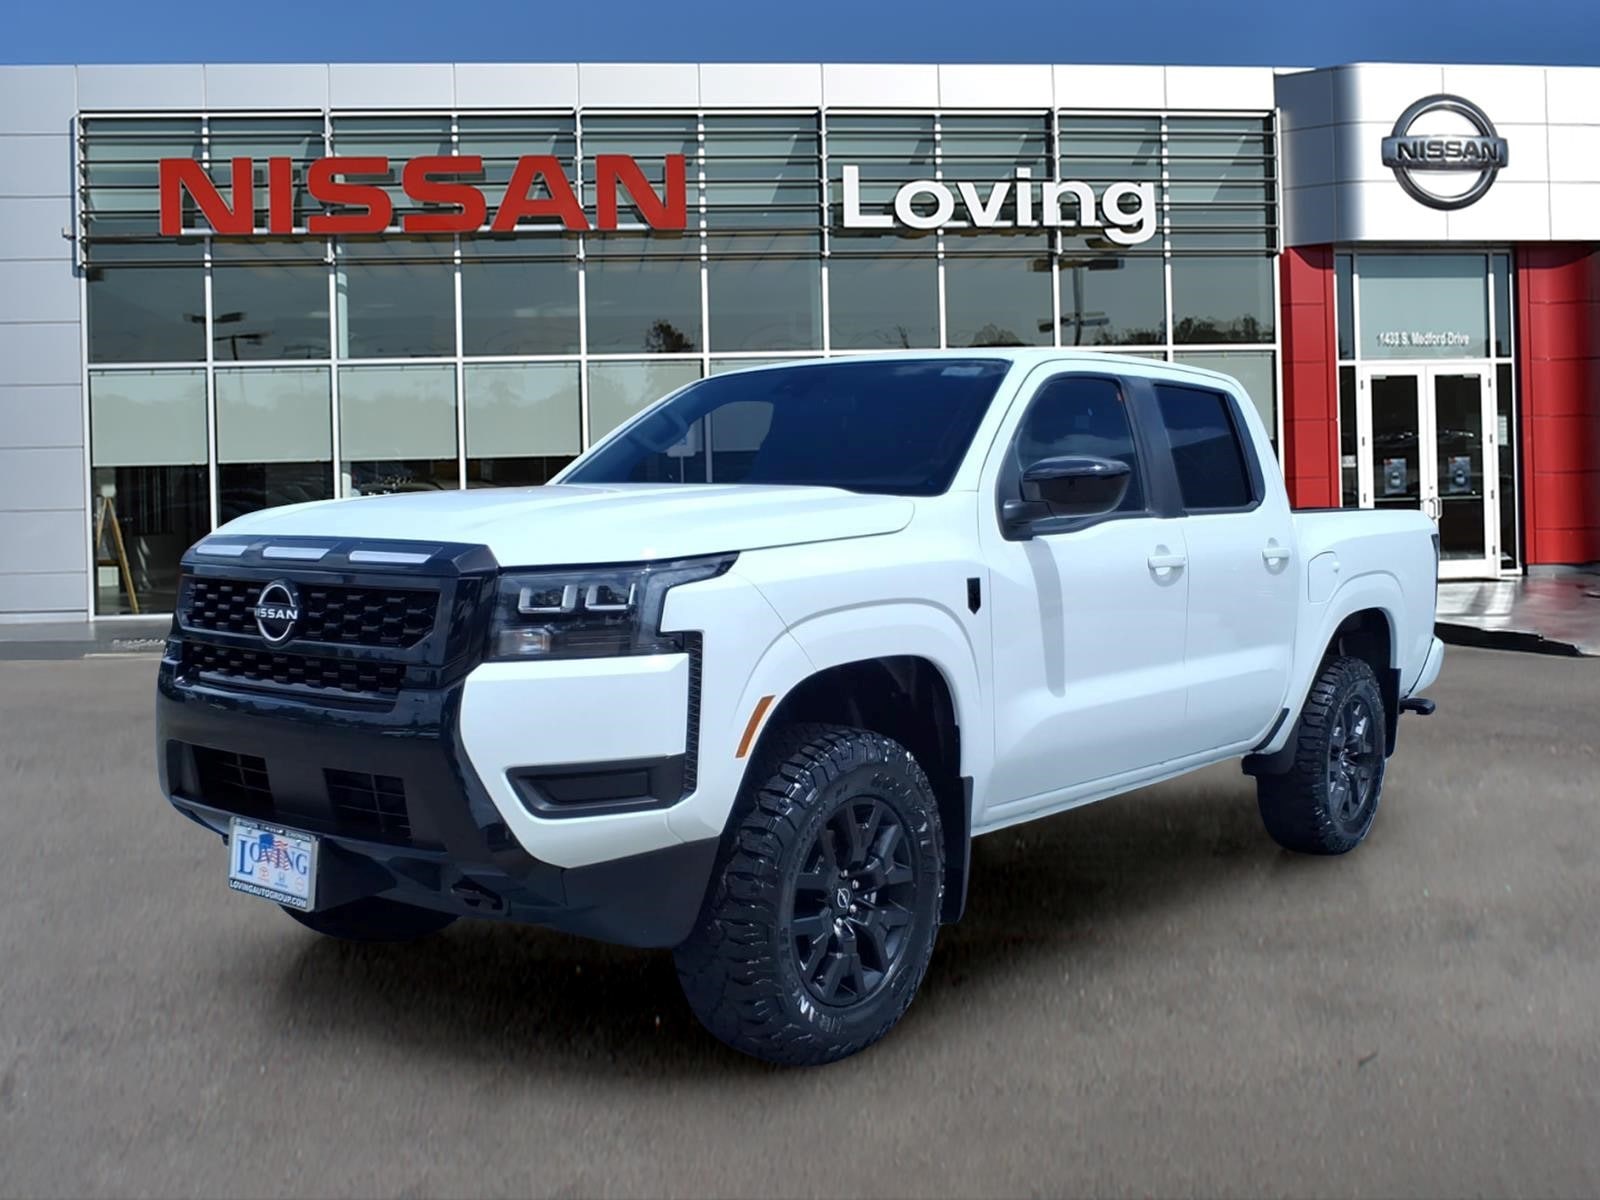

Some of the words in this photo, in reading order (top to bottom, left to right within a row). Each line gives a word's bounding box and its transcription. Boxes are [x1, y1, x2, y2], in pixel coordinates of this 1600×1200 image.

[1397, 140, 1498, 161] NISSAN
[159, 154, 687, 235] NISSAN
[842, 165, 1157, 245] Loving
[1411, 331, 1447, 345] Medford
[1447, 331, 1470, 345] Drive
[238, 839, 308, 876] LOVING
[229, 879, 307, 908] LOVINGAUTOGROUP.COM
